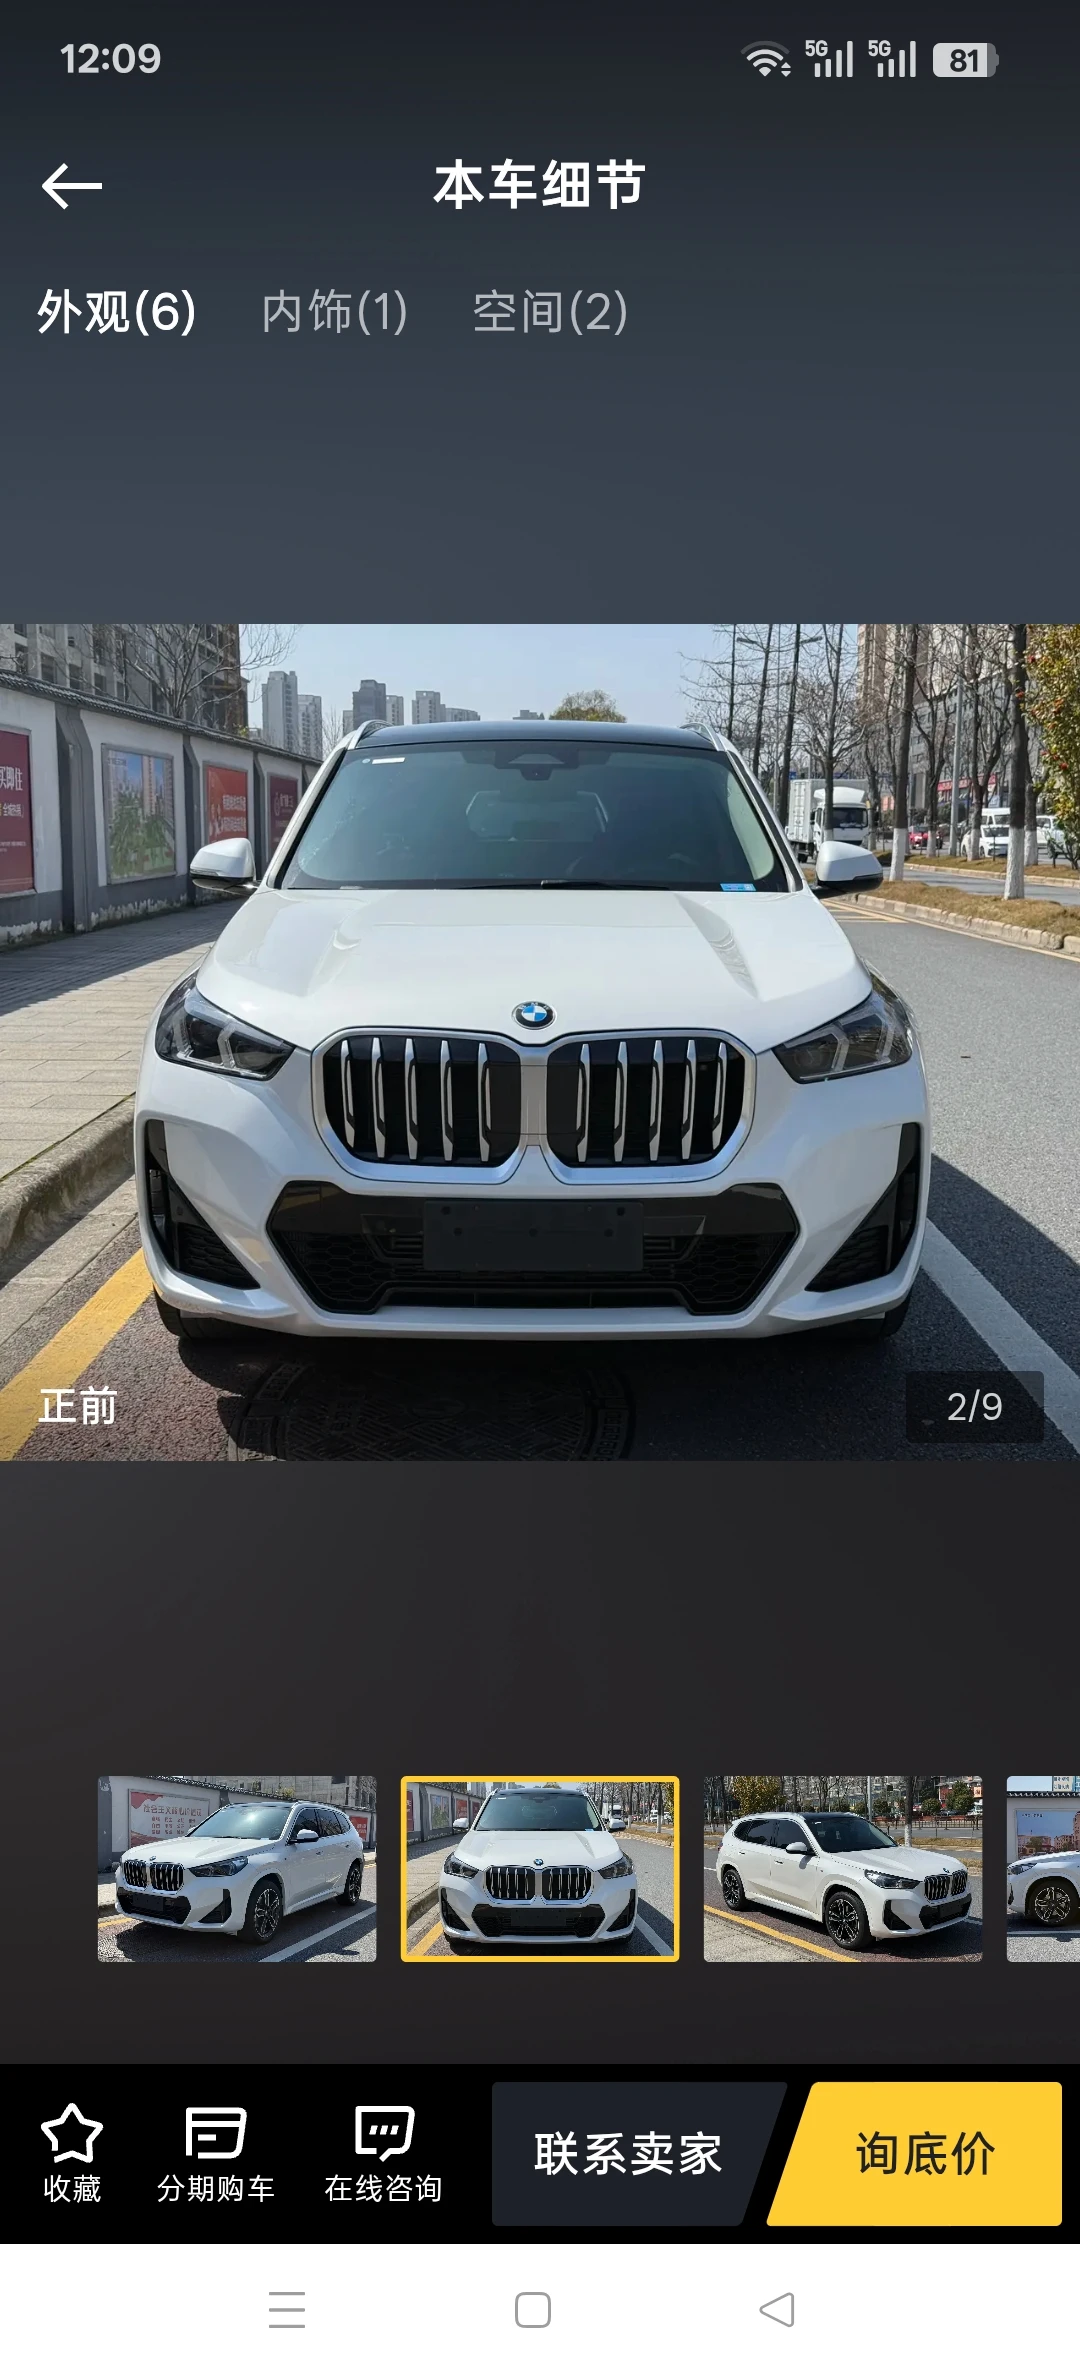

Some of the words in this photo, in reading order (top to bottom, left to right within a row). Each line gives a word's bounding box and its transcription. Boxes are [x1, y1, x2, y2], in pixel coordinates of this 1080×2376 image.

[60, 42, 161, 74] 12:09
[804, 39, 829, 57] 5G
[867, 39, 892, 57] 5G
[949, 48, 979, 73] 81
[433, 157, 646, 210] 本车细节
[36, 288, 195, 337] 外观(6)
[263, 288, 408, 337] 内饰(1)
[473, 288, 628, 337] 空间(2)
[533, 2130, 723, 2176] 联系卖家
[855, 2130, 996, 2176] 询底价
[43, 2173, 102, 2203] 收藏
[156, 2173, 275, 2203] 分期购车
[324, 2173, 442, 2203] 在线咨询
